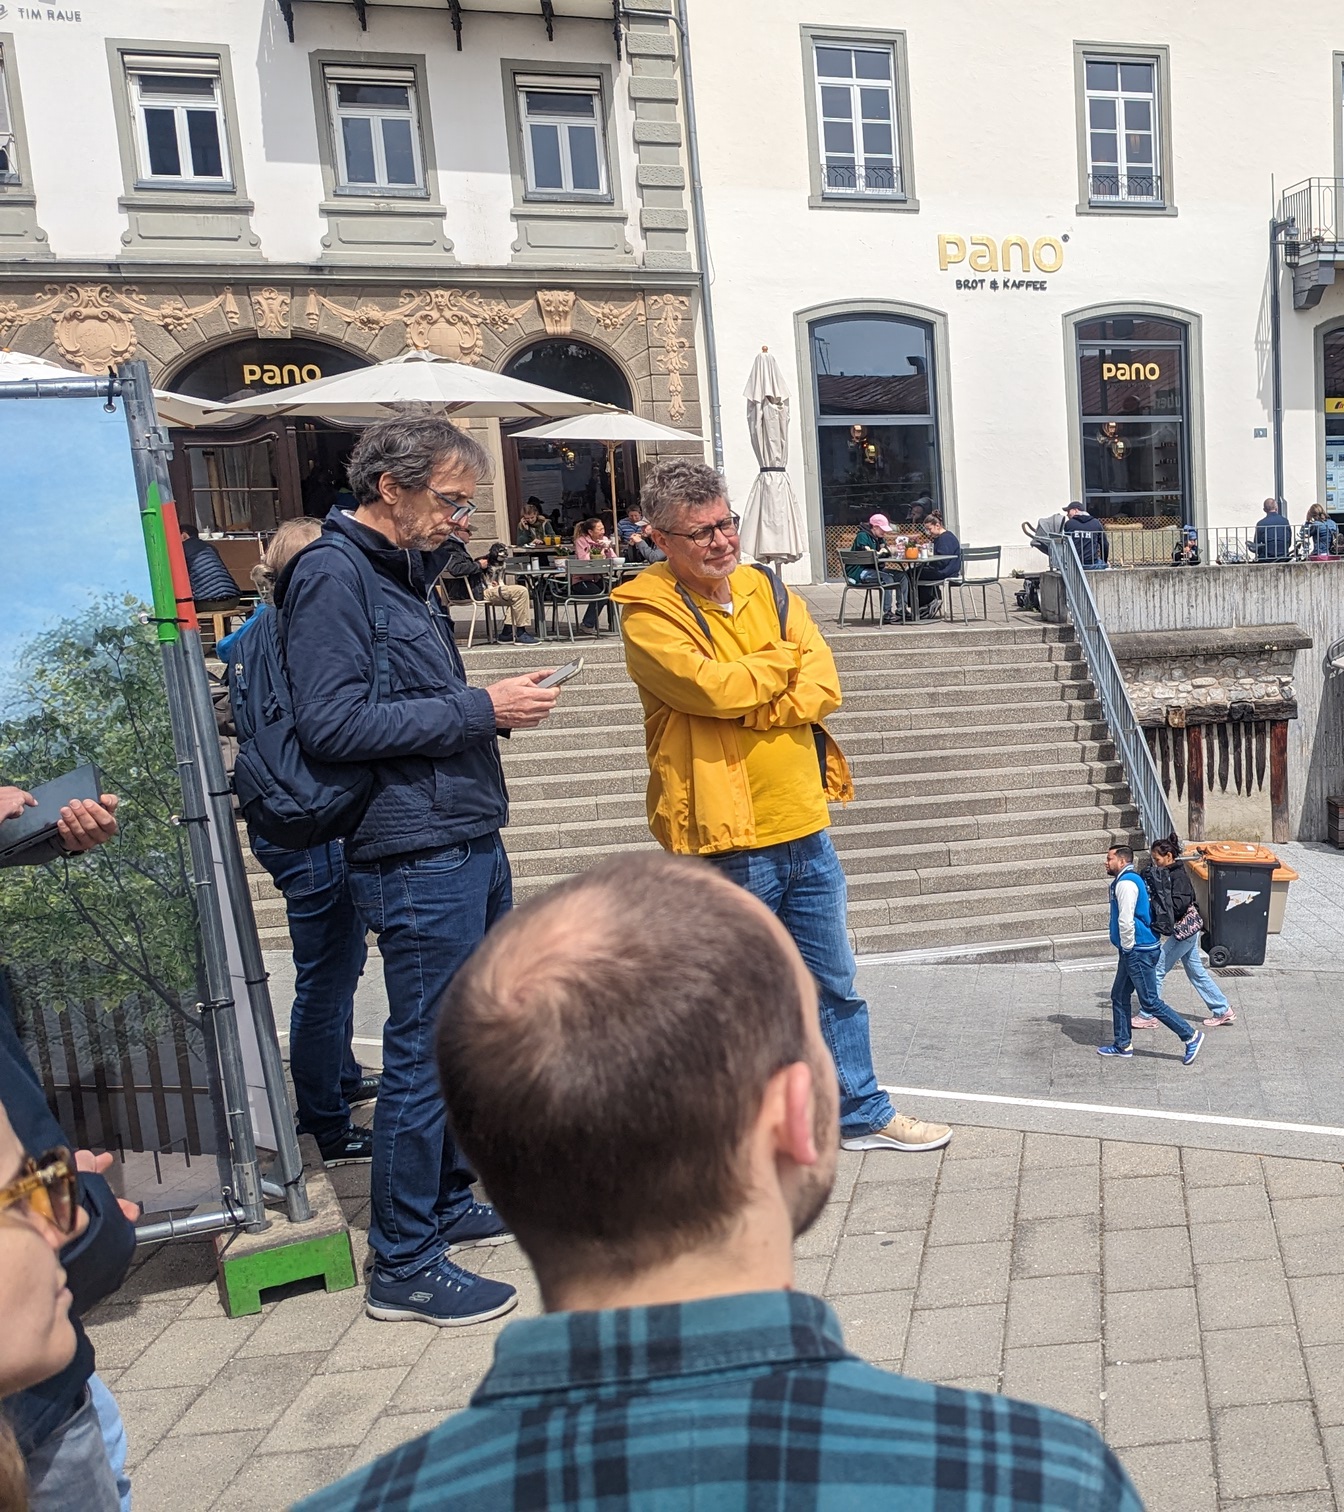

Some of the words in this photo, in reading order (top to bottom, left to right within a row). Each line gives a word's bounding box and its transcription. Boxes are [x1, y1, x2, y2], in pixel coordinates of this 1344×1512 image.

[18, 8, 41, 20] TIM
[47, 10, 81, 22] RAUE
[956, 279, 985, 290] BROT
[990, 278, 999, 292] &
[1003, 279, 1047, 290] KAFFEE
